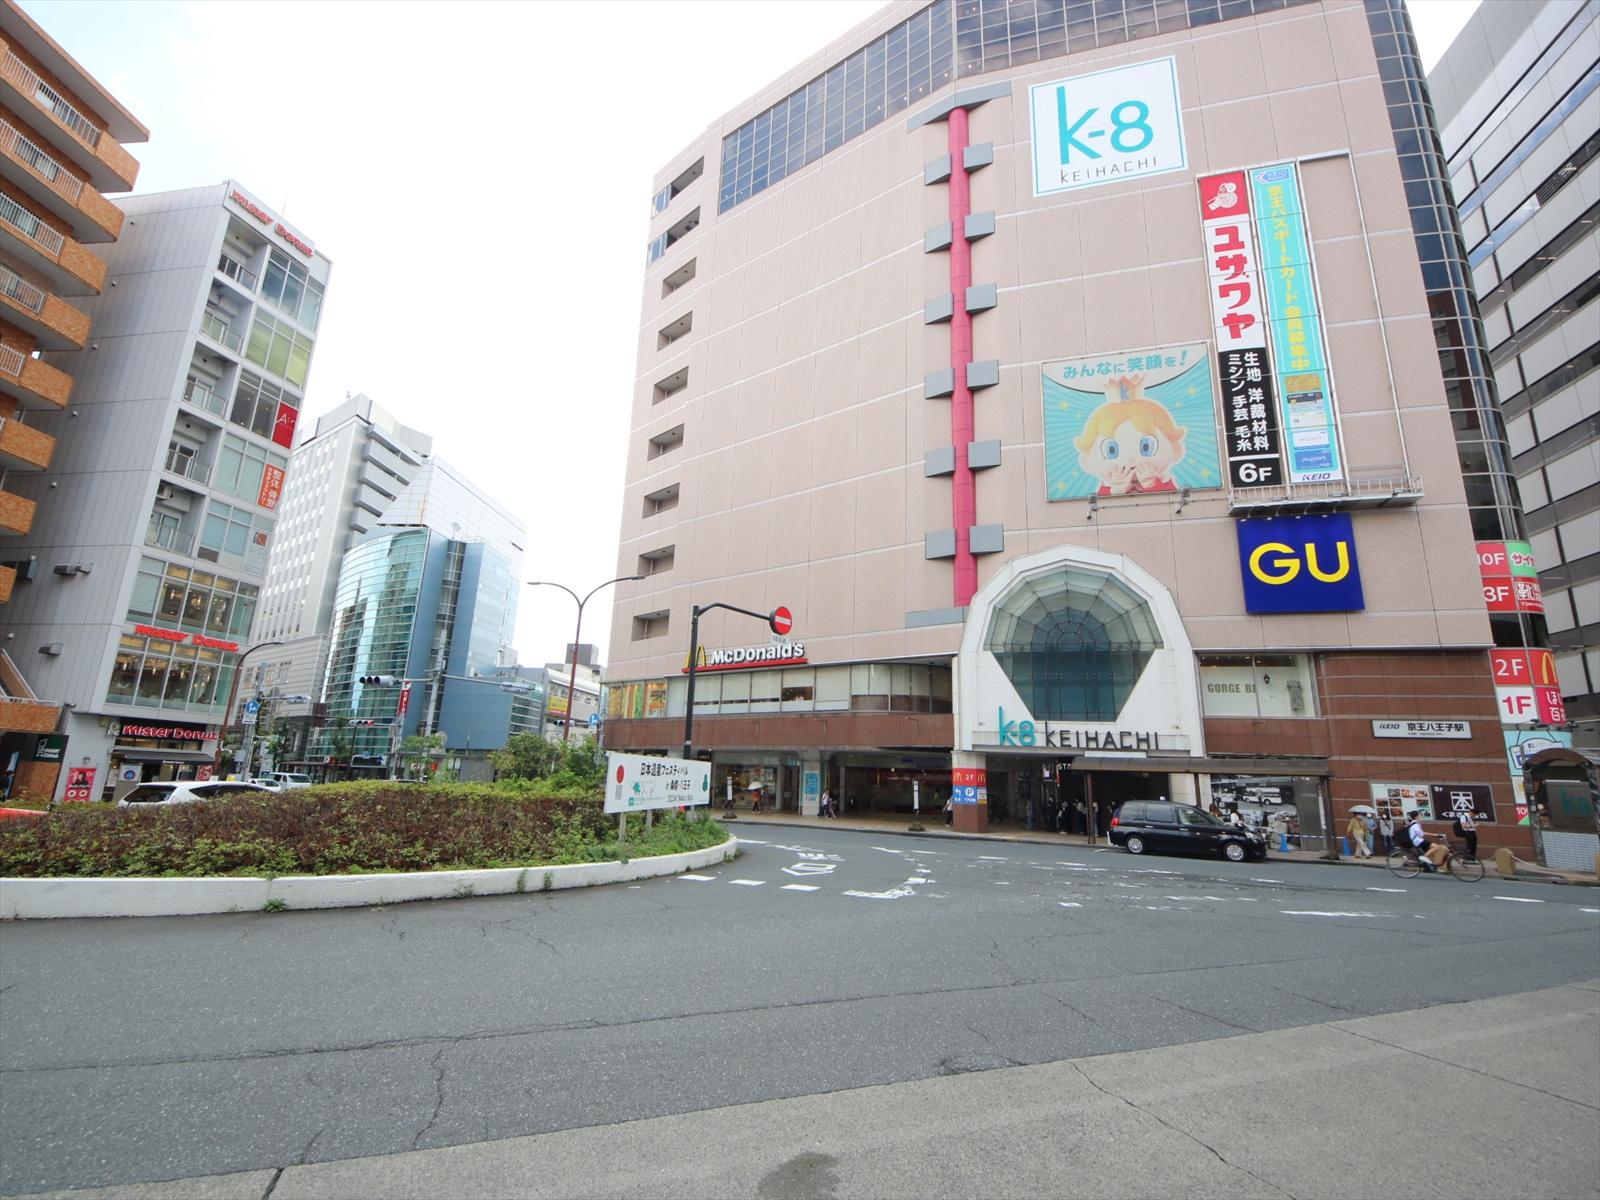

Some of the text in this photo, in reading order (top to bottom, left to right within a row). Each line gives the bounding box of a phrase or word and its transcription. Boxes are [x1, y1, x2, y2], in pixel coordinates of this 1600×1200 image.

[1056, 86, 1153, 165] k-8
[1213, 225, 1256, 340] ユザワヤ
[1228, 353, 1253, 452] ミシン 手芸 毛糸
[1243, 351, 1270, 452] 生地 洋裁材料
[1239, 463, 1272, 483] 6F
[1302, 472, 1331, 482] KEIO
[1249, 541, 1350, 585] GU
[1483, 586, 1509, 602] 3F
[711, 642, 804, 665] McDonald's
[1495, 658, 1523, 676] 2F
[1207, 683, 1241, 693] GORGE
[1502, 696, 1531, 715] 1F
[173, 728, 217, 741] Donut
[998, 706, 1036, 746] k-8
[1045, 721, 1159, 750] KEIHACHI
[1407, 723, 1464, 732] 京王八王子駅
